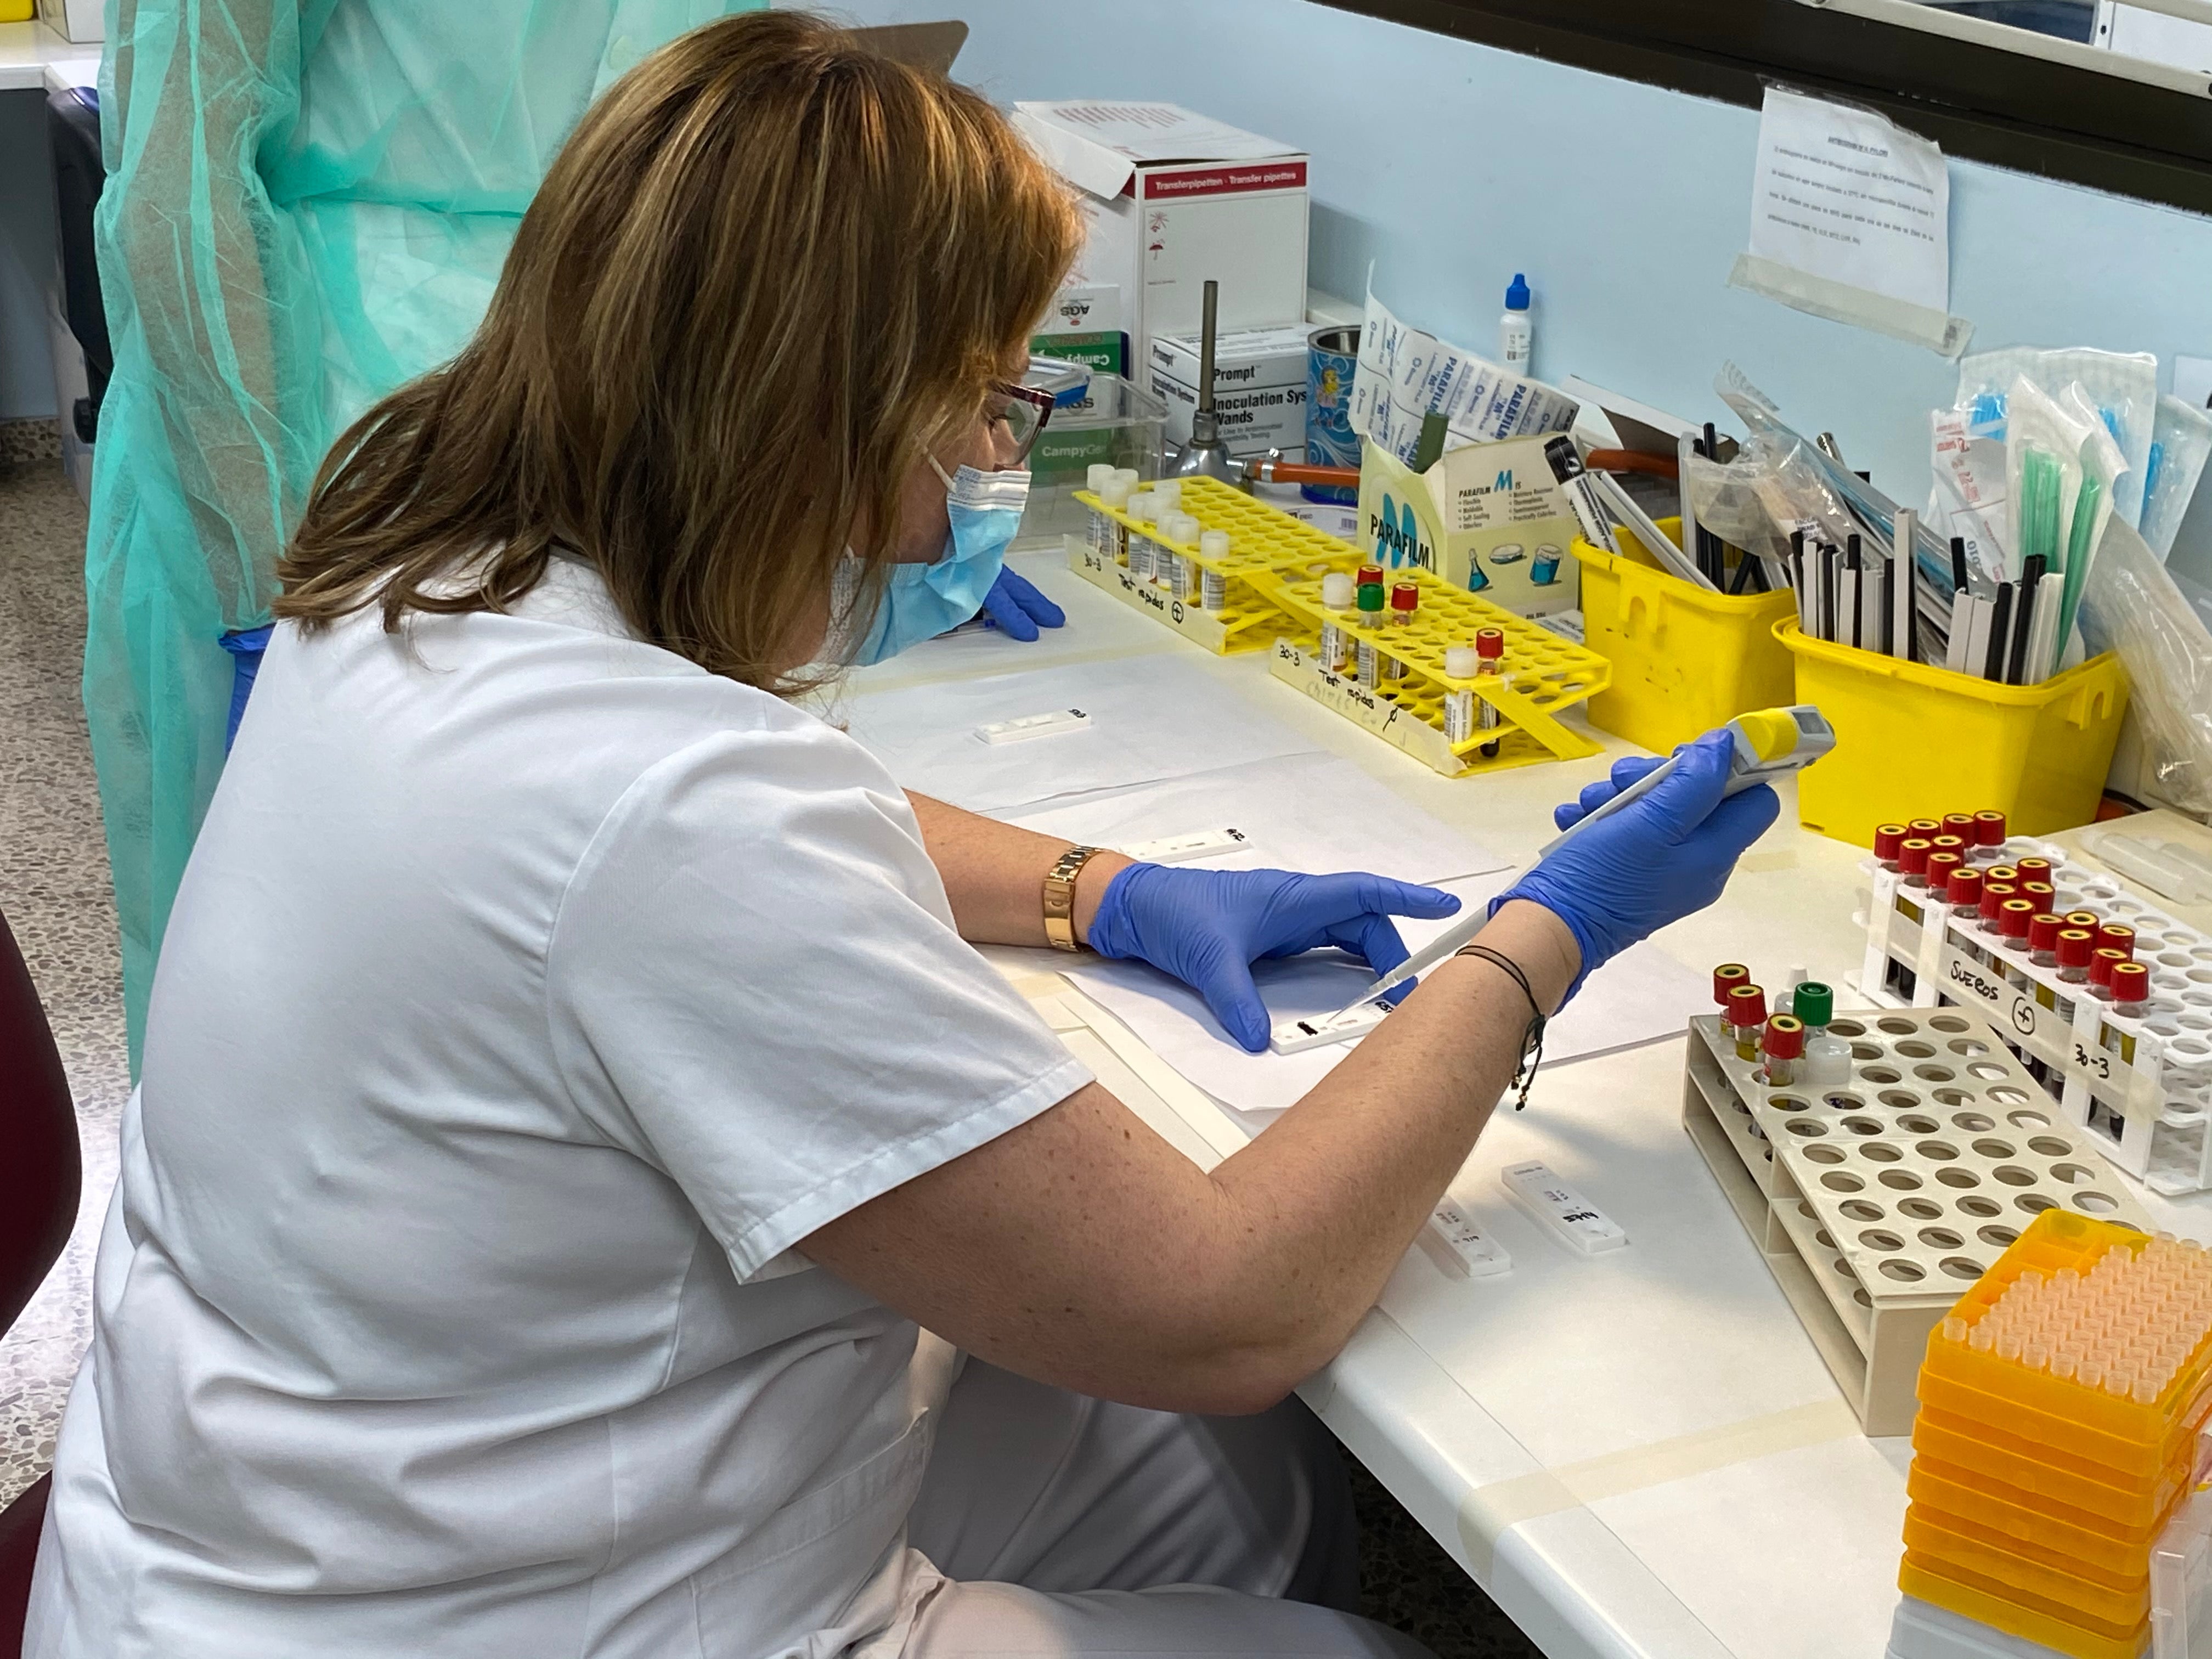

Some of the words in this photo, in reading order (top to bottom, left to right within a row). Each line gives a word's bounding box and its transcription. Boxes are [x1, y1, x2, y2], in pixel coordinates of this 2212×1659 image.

[1229, 173, 1262, 185] Transfer
[1214, 392, 1283, 410] Inoculation
[1286, 390, 1307, 405] Sys
[1495, 383, 1527, 439] PARAFILM
[1458, 486, 1491, 498] PARAFILM
[1493, 469, 1513, 493] M
[1370, 513, 1430, 569] PARAFILM
[1085, 553, 1102, 572] 30-3
[1279, 645, 1300, 667] 30-3
[1318, 669, 1341, 689] Test
[1951, 961, 1999, 1000] SUEROS
[2075, 1043, 2109, 1079] 30-3
